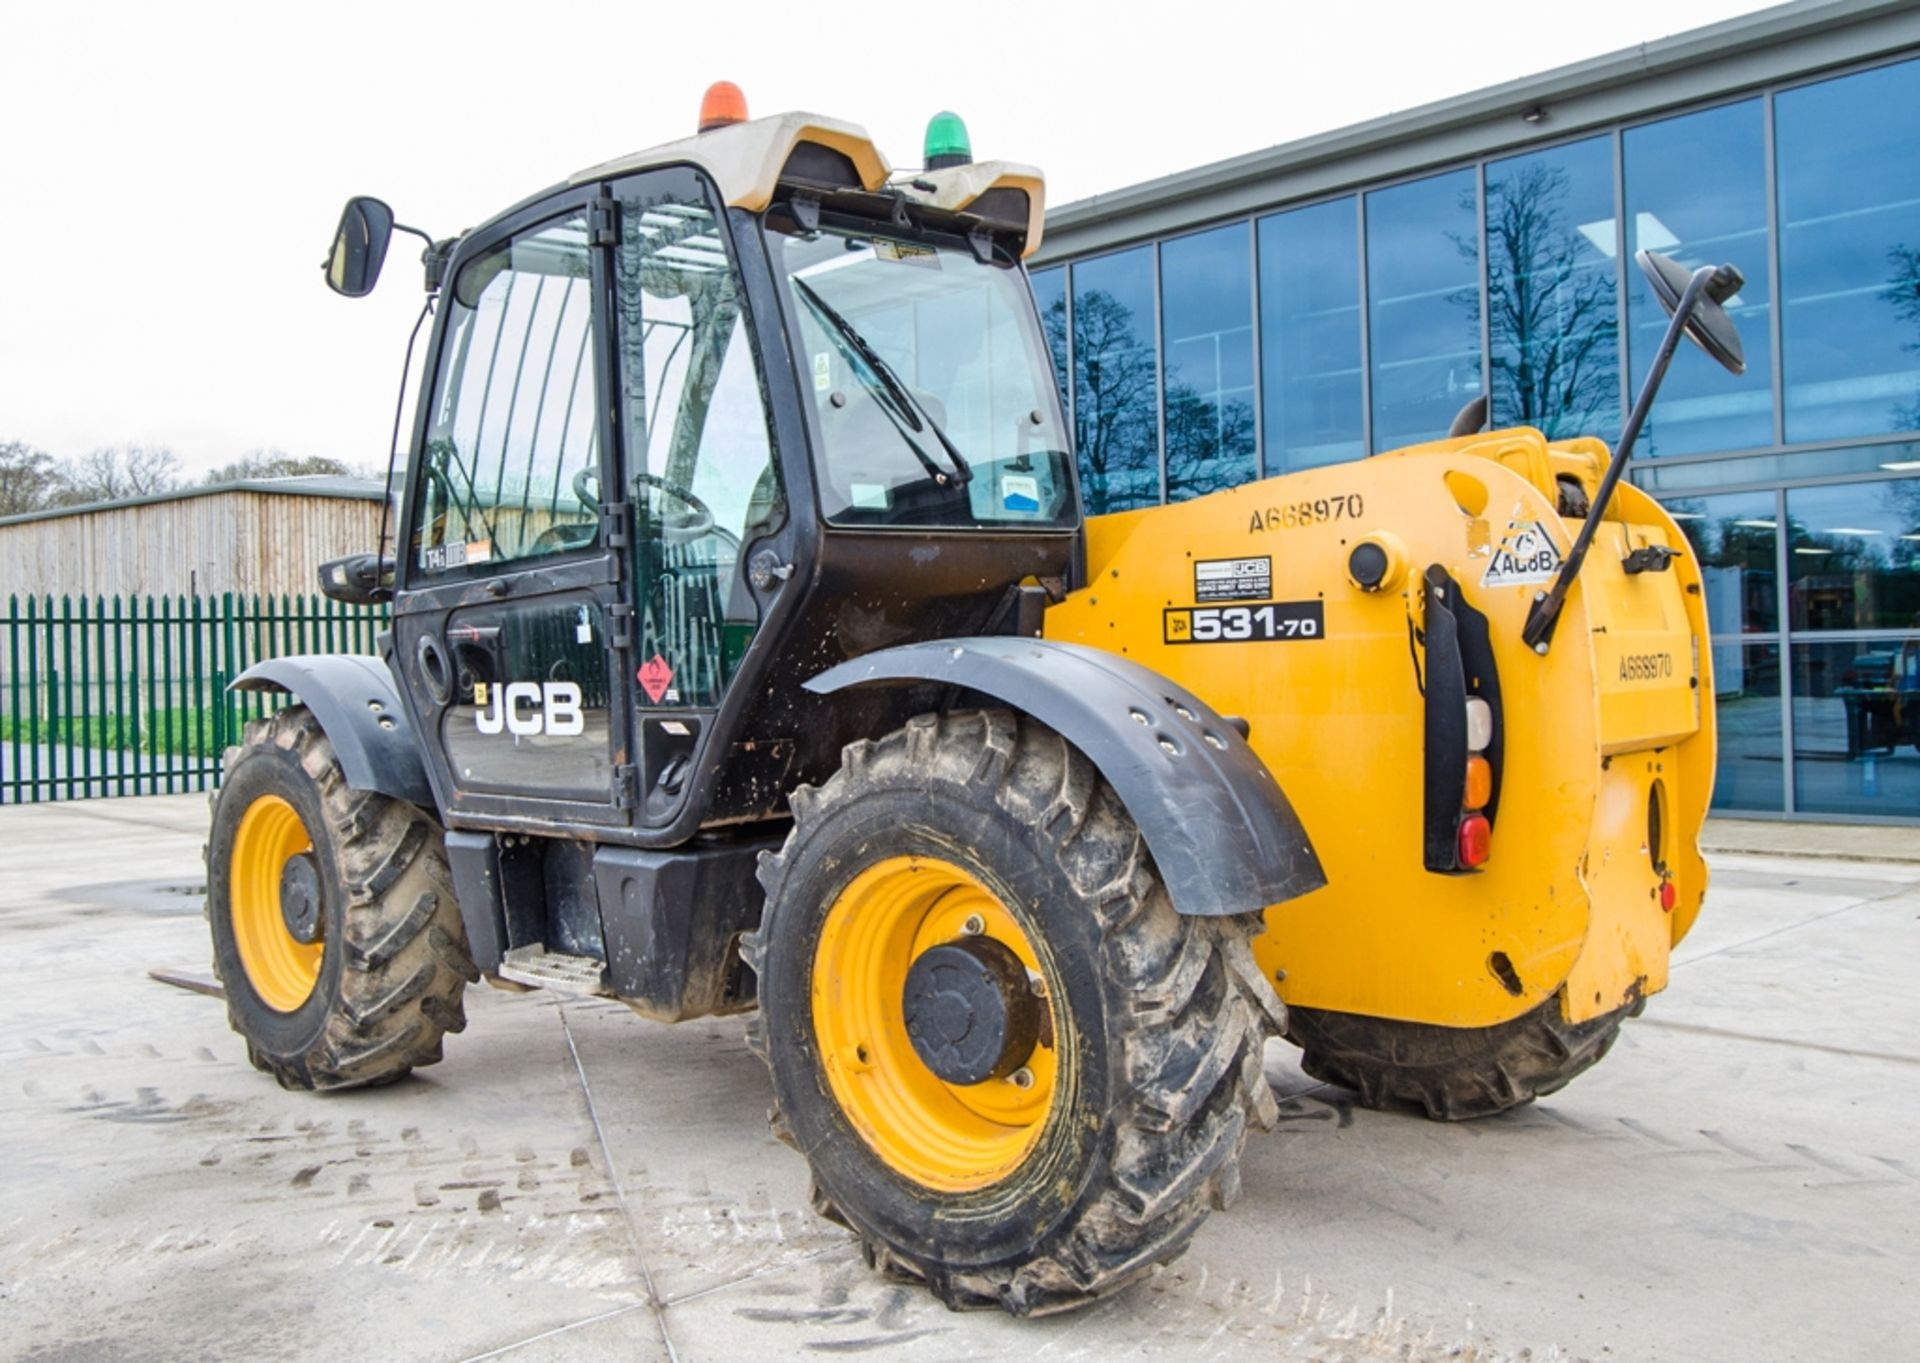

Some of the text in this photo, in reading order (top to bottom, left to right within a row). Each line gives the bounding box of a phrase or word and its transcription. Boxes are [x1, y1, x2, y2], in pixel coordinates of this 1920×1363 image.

[1249, 493, 1364, 534] A668970
[1236, 560, 1268, 576] JCB
[1193, 606, 1317, 640] 531-70
[475, 682, 584, 736] JCB
